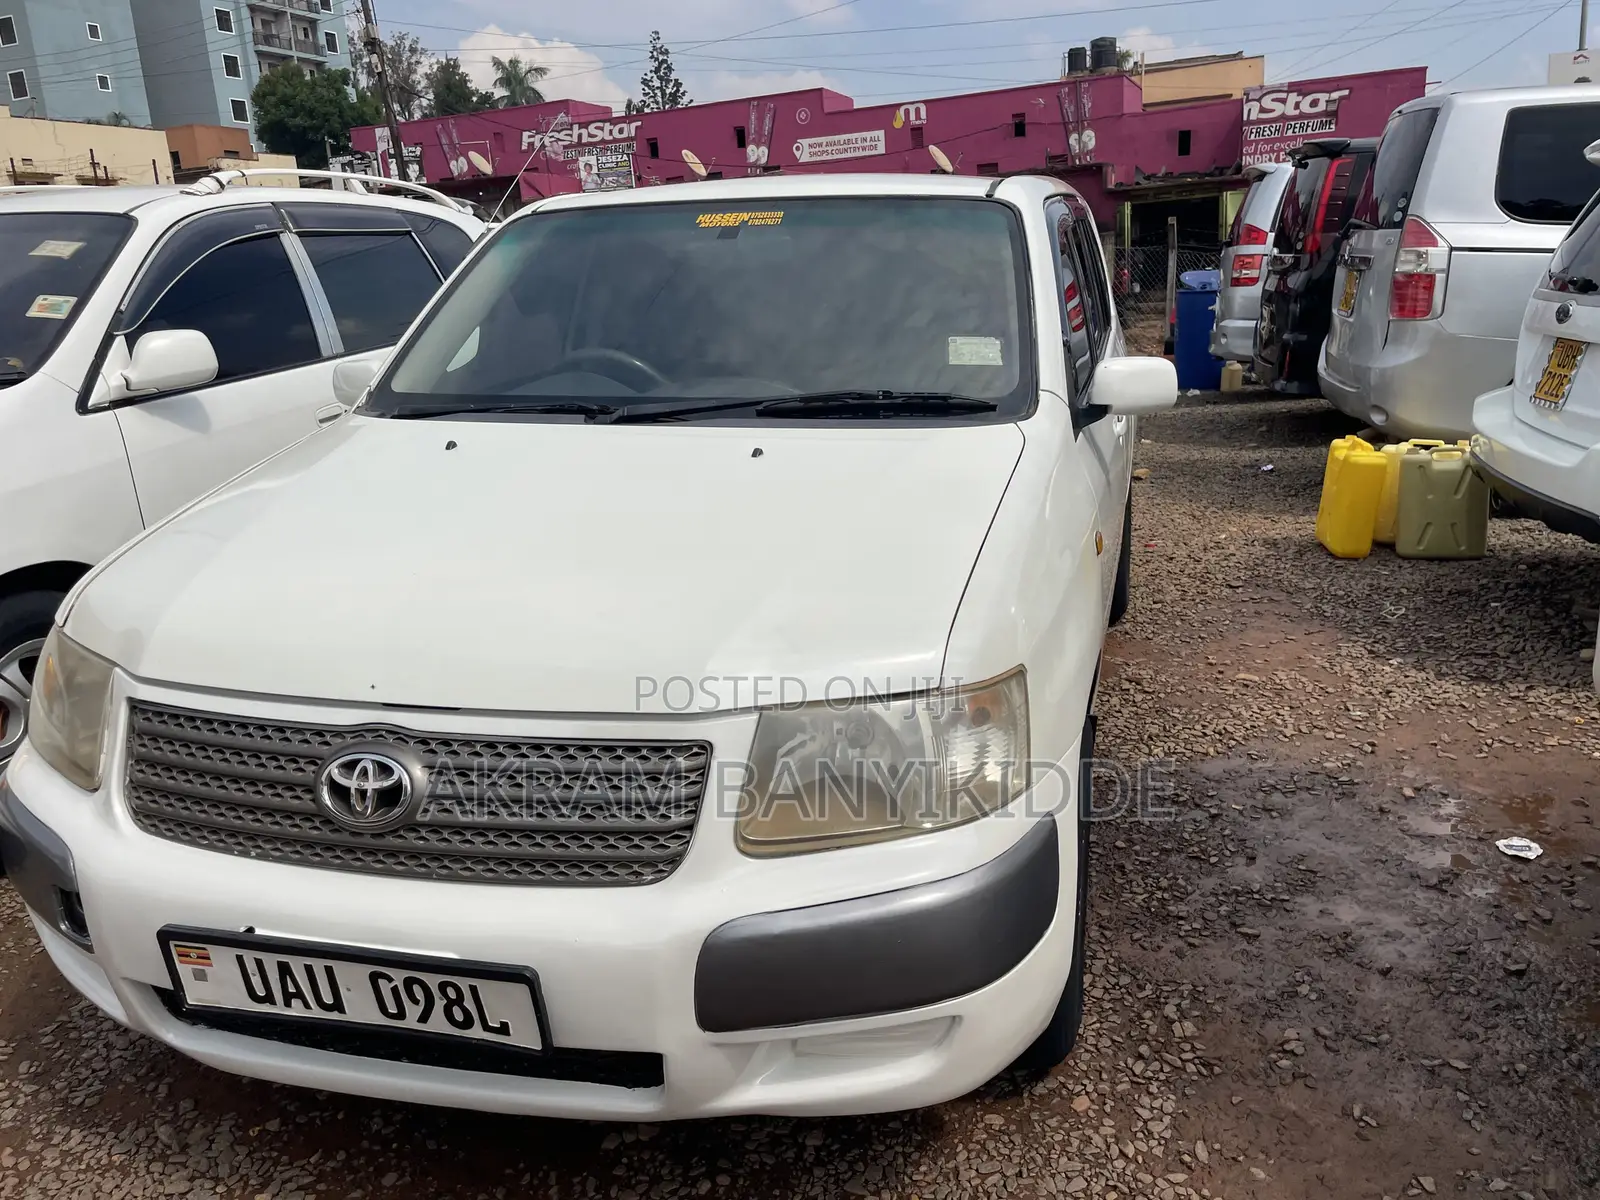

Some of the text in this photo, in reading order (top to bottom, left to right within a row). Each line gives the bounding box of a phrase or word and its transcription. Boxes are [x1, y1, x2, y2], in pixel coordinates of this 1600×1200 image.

[521, 121, 642, 150] FreshStar
[1249, 124, 1281, 139] FRESH
[1285, 119, 1335, 135] PERFUME
[605, 142, 635, 156] PERFUME
[808, 135, 881, 150] NOW AVAILABLE IN ALL
[1257, 141, 1272, 154] for
[1273, 137, 1304, 150] excell
[808, 144, 878, 158] SHOPS COUNTRYWIDE
[695, 213, 751, 223] HUSSEIN
[699, 220, 740, 228] MOTORS
[235, 953, 512, 1037] UAU 098L
